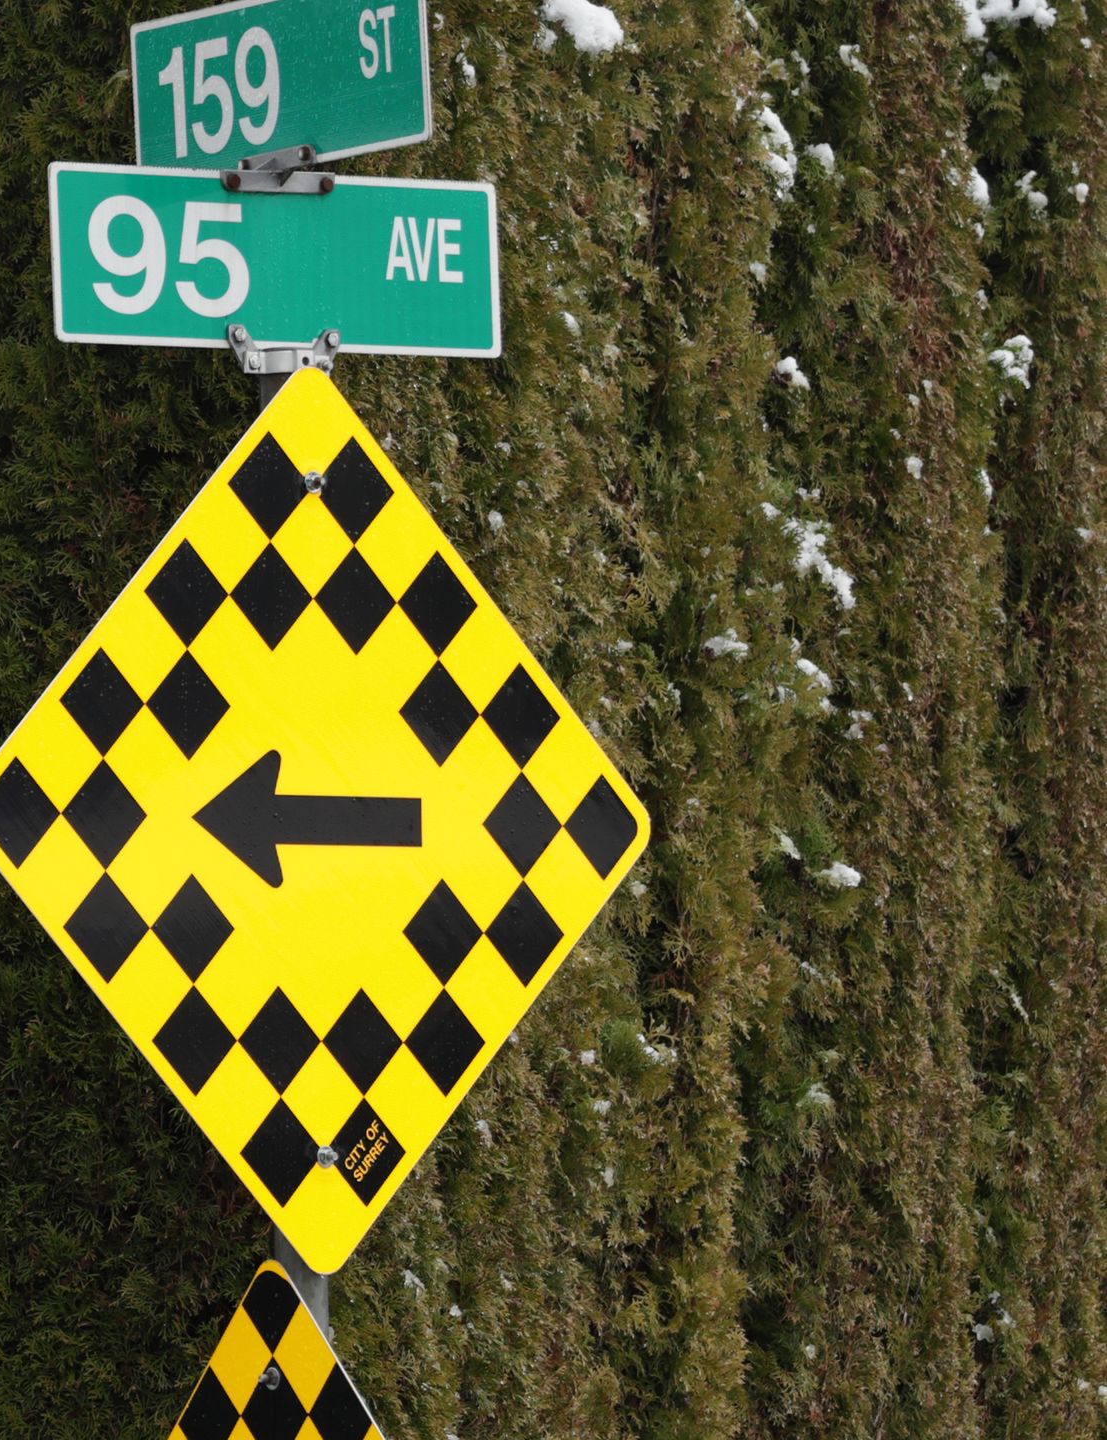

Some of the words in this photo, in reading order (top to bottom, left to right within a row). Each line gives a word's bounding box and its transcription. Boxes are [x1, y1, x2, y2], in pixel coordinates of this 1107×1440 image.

[159, 26, 281, 159] 159
[358, 5, 396, 80] ST
[87, 194, 251, 319] 95
[386, 216, 464, 284] AVE
[344, 1139, 367, 1170] CITY
[365, 1119, 381, 1141] OF
[353, 1132, 390, 1182] SURREY
